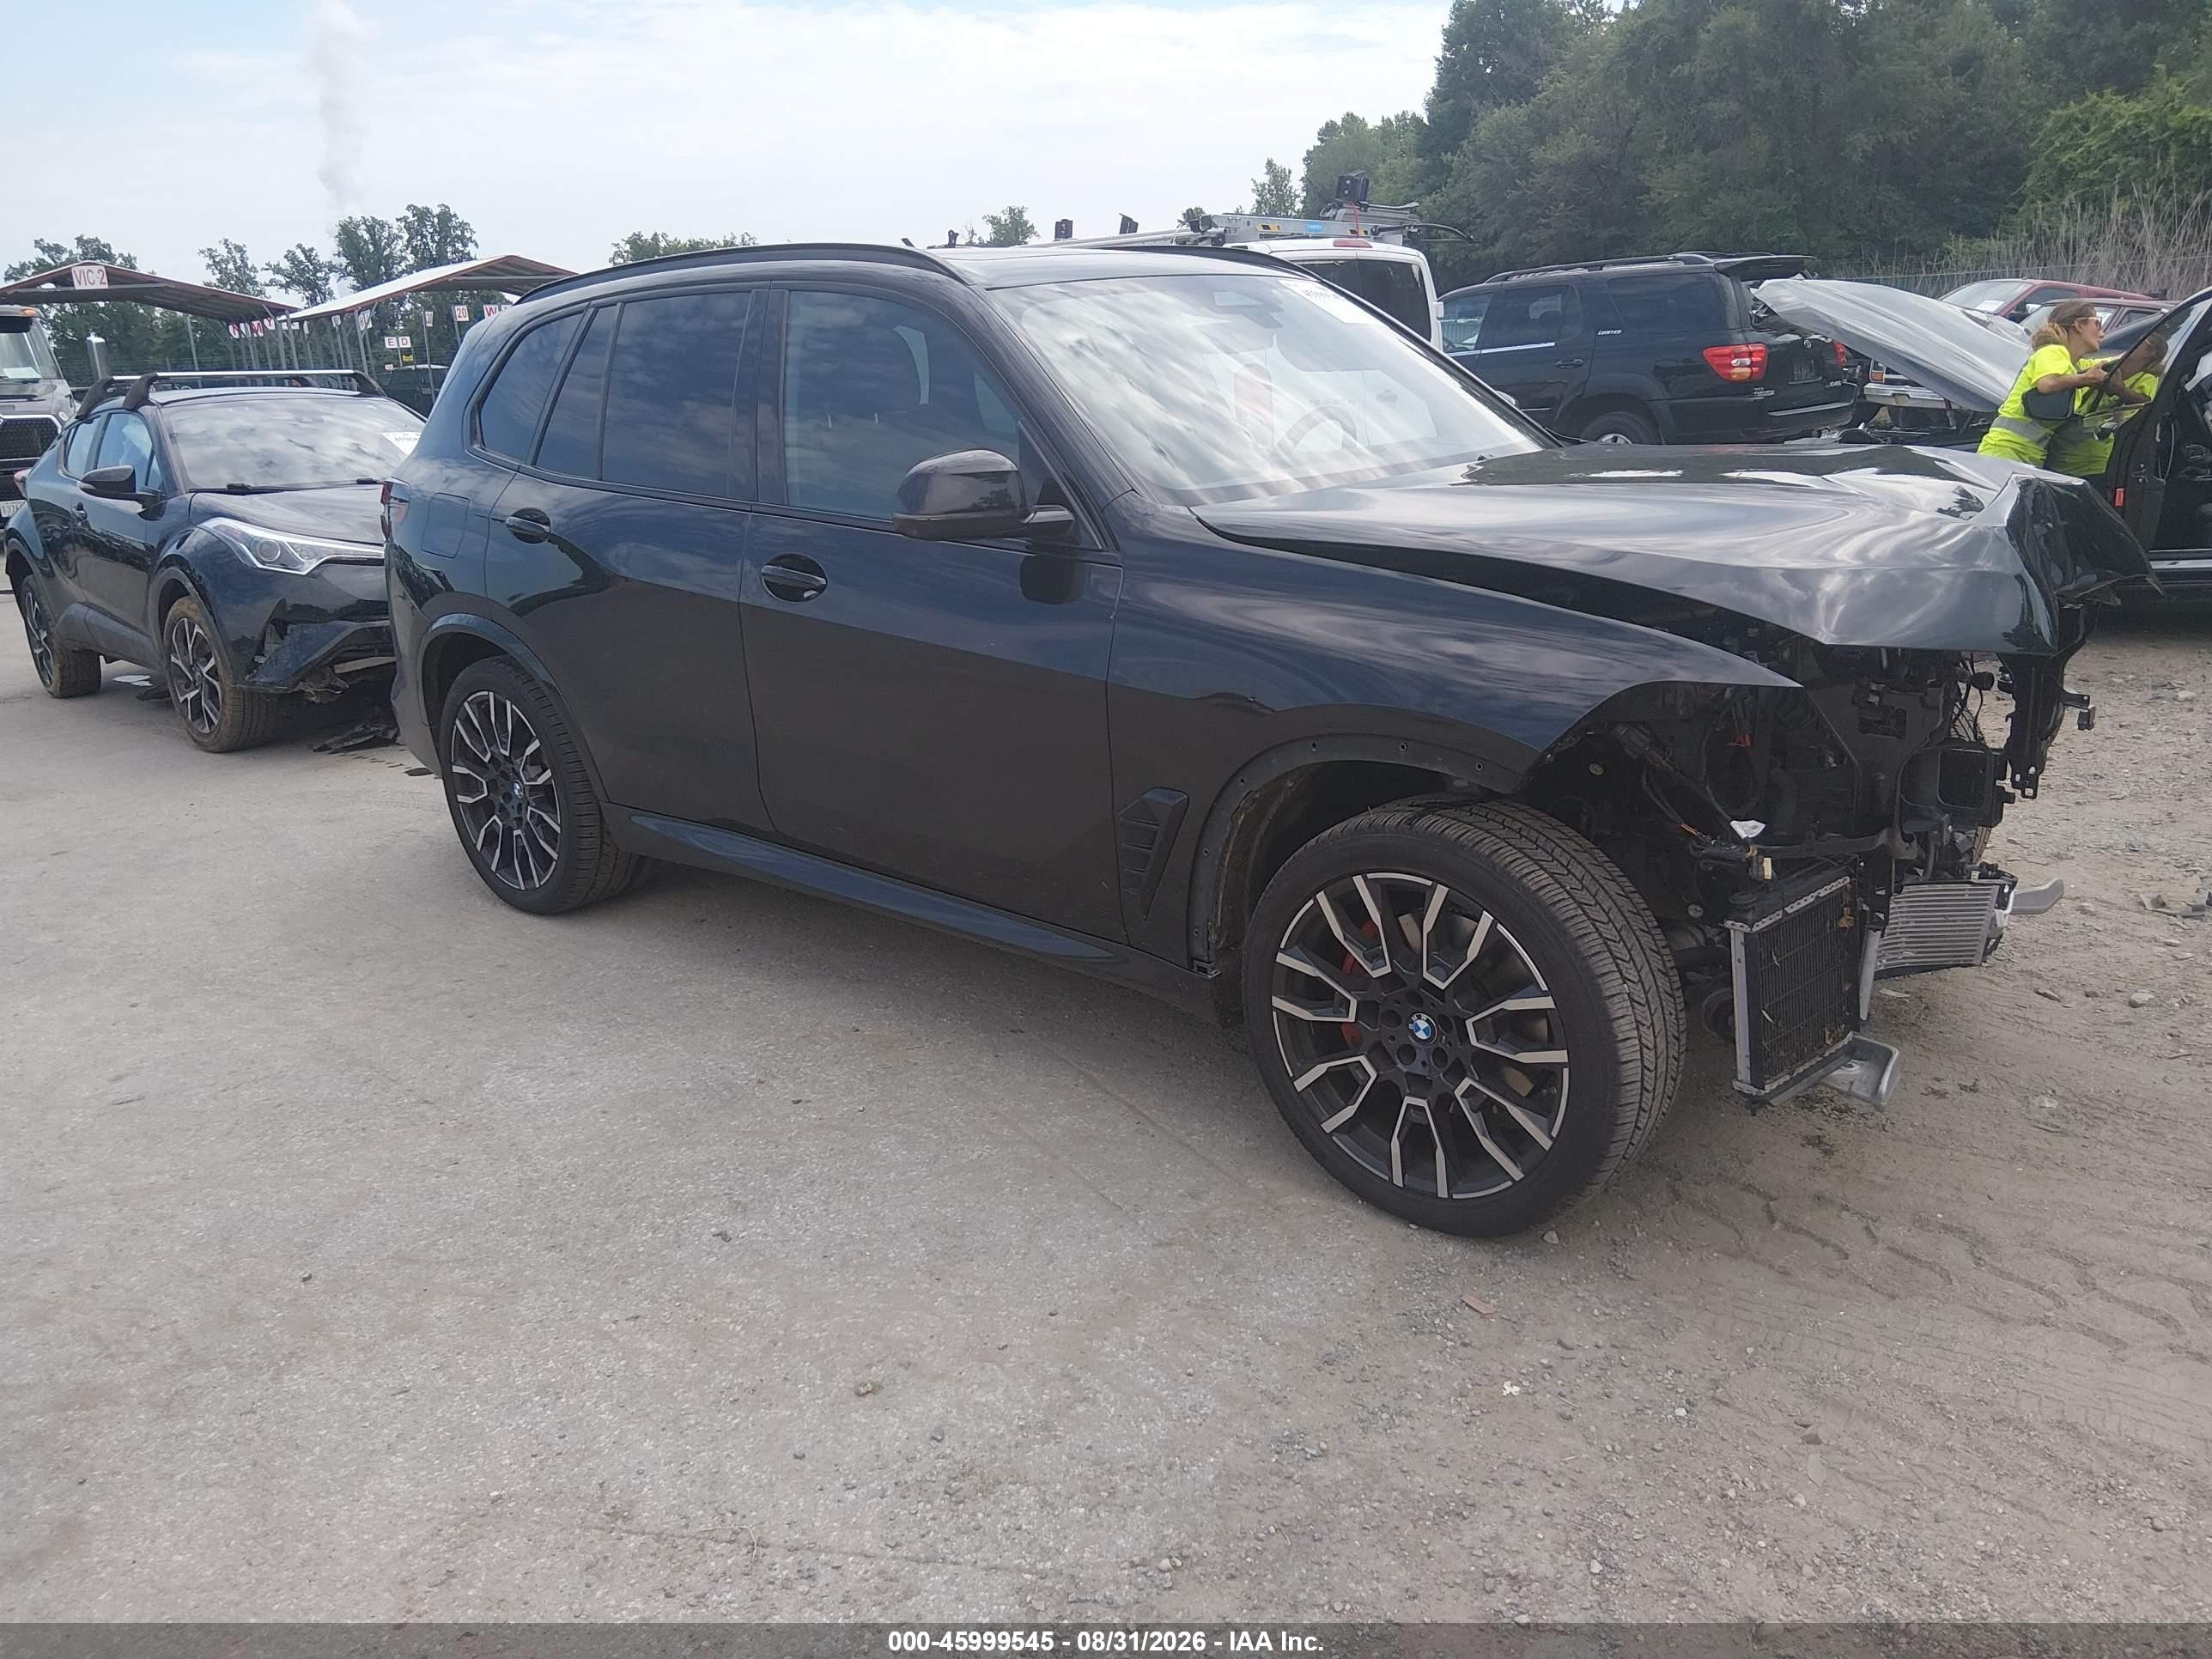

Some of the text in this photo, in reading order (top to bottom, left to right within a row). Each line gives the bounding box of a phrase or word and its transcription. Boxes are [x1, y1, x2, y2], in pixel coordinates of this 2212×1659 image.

[457, 308, 467, 318] 20
[387, 337, 395, 346] E
[401, 337, 408, 346] D
